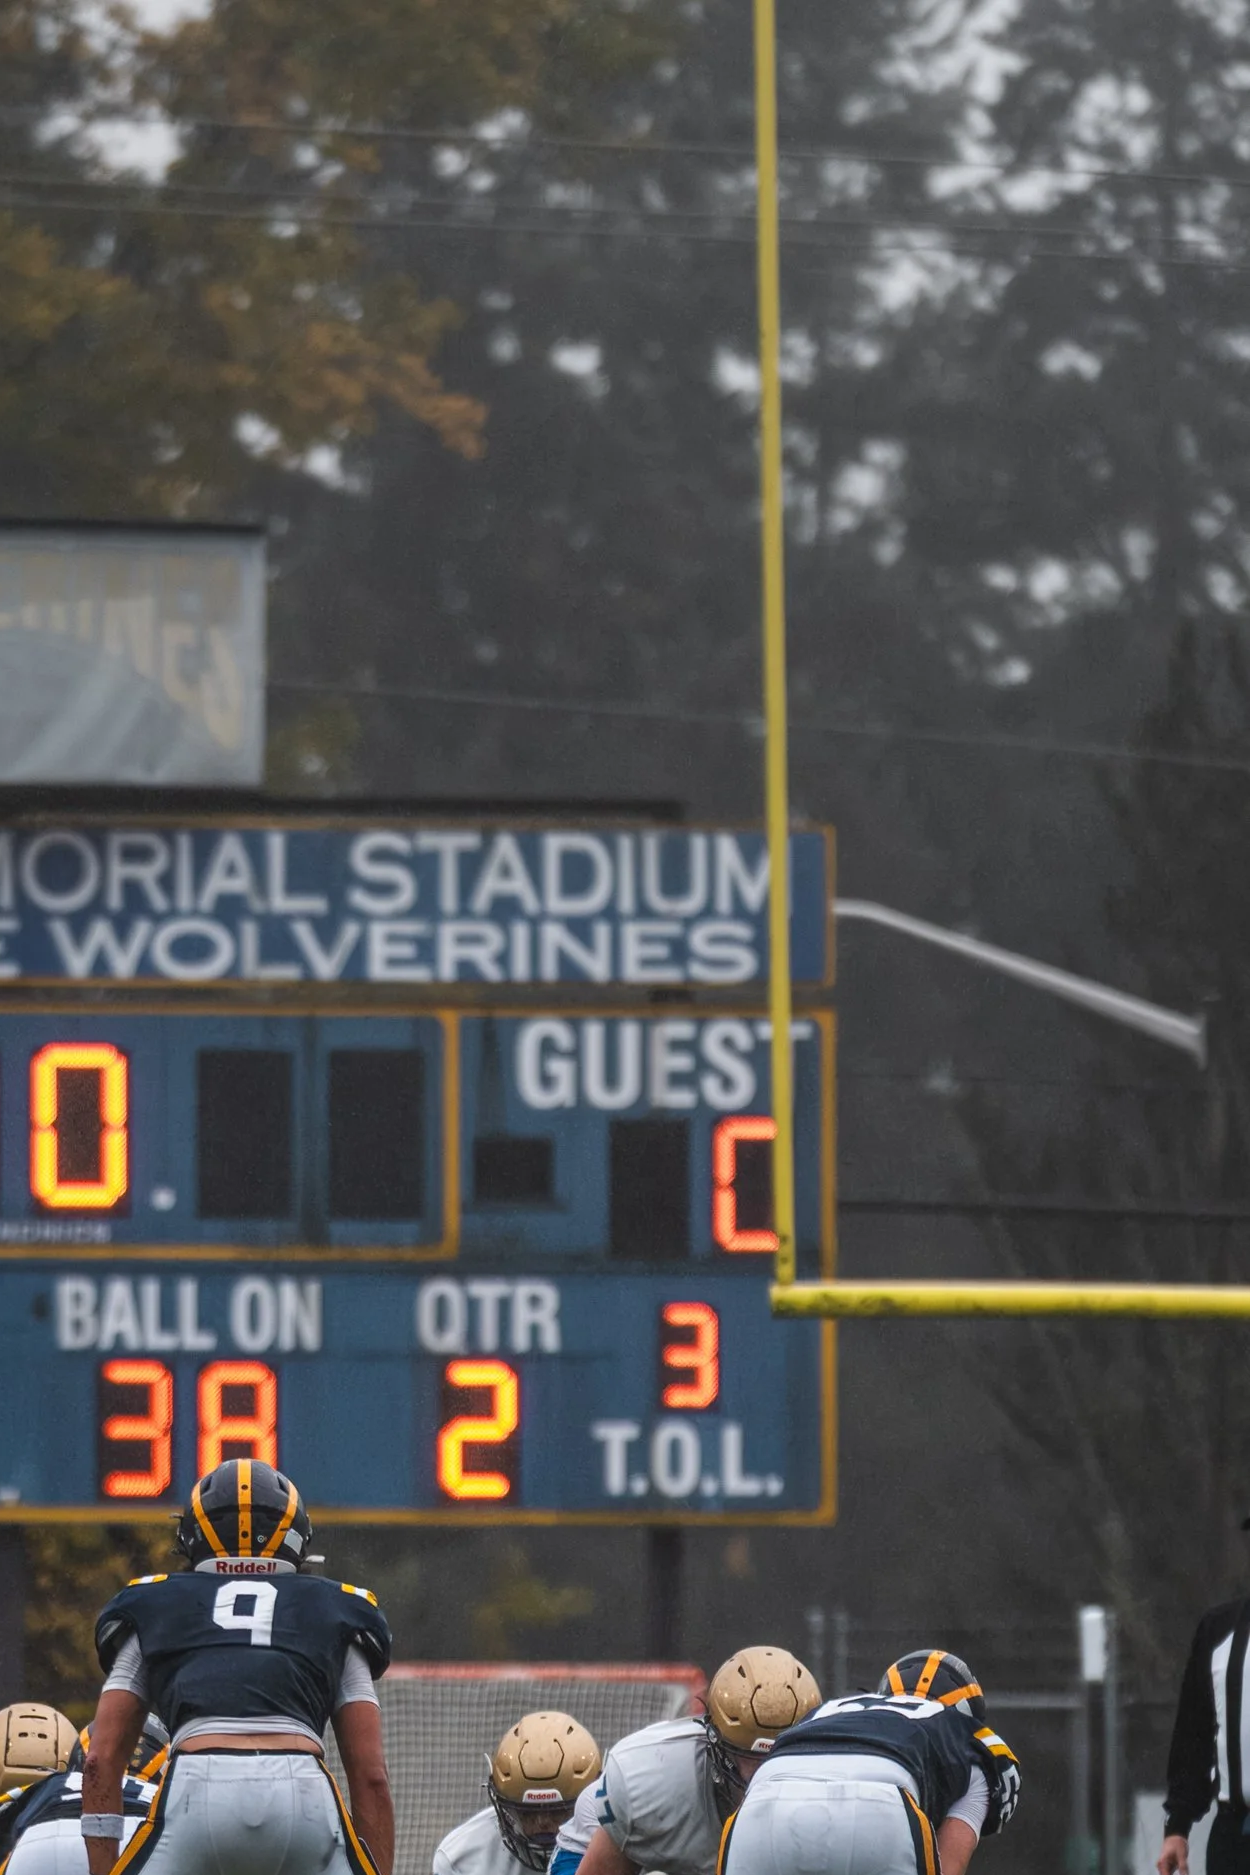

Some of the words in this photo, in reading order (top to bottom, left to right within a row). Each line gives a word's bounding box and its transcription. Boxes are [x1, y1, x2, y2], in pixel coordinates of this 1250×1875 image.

[349, 831, 791, 917] STADIUM
[50, 918, 758, 983] WOLVERINES
[57, 1278, 216, 1350] BALL
[230, 1277, 322, 1352] ON
[416, 1278, 561, 1354] QTR
[662, 1301, 720, 1409] 3
[102, 1359, 278, 1497] 38
[436, 1359, 519, 1500] 2
[592, 1421, 784, 1498] T.O.L.
[216, 1561, 277, 1574] Riddell
[212, 1580, 278, 1646] 9
